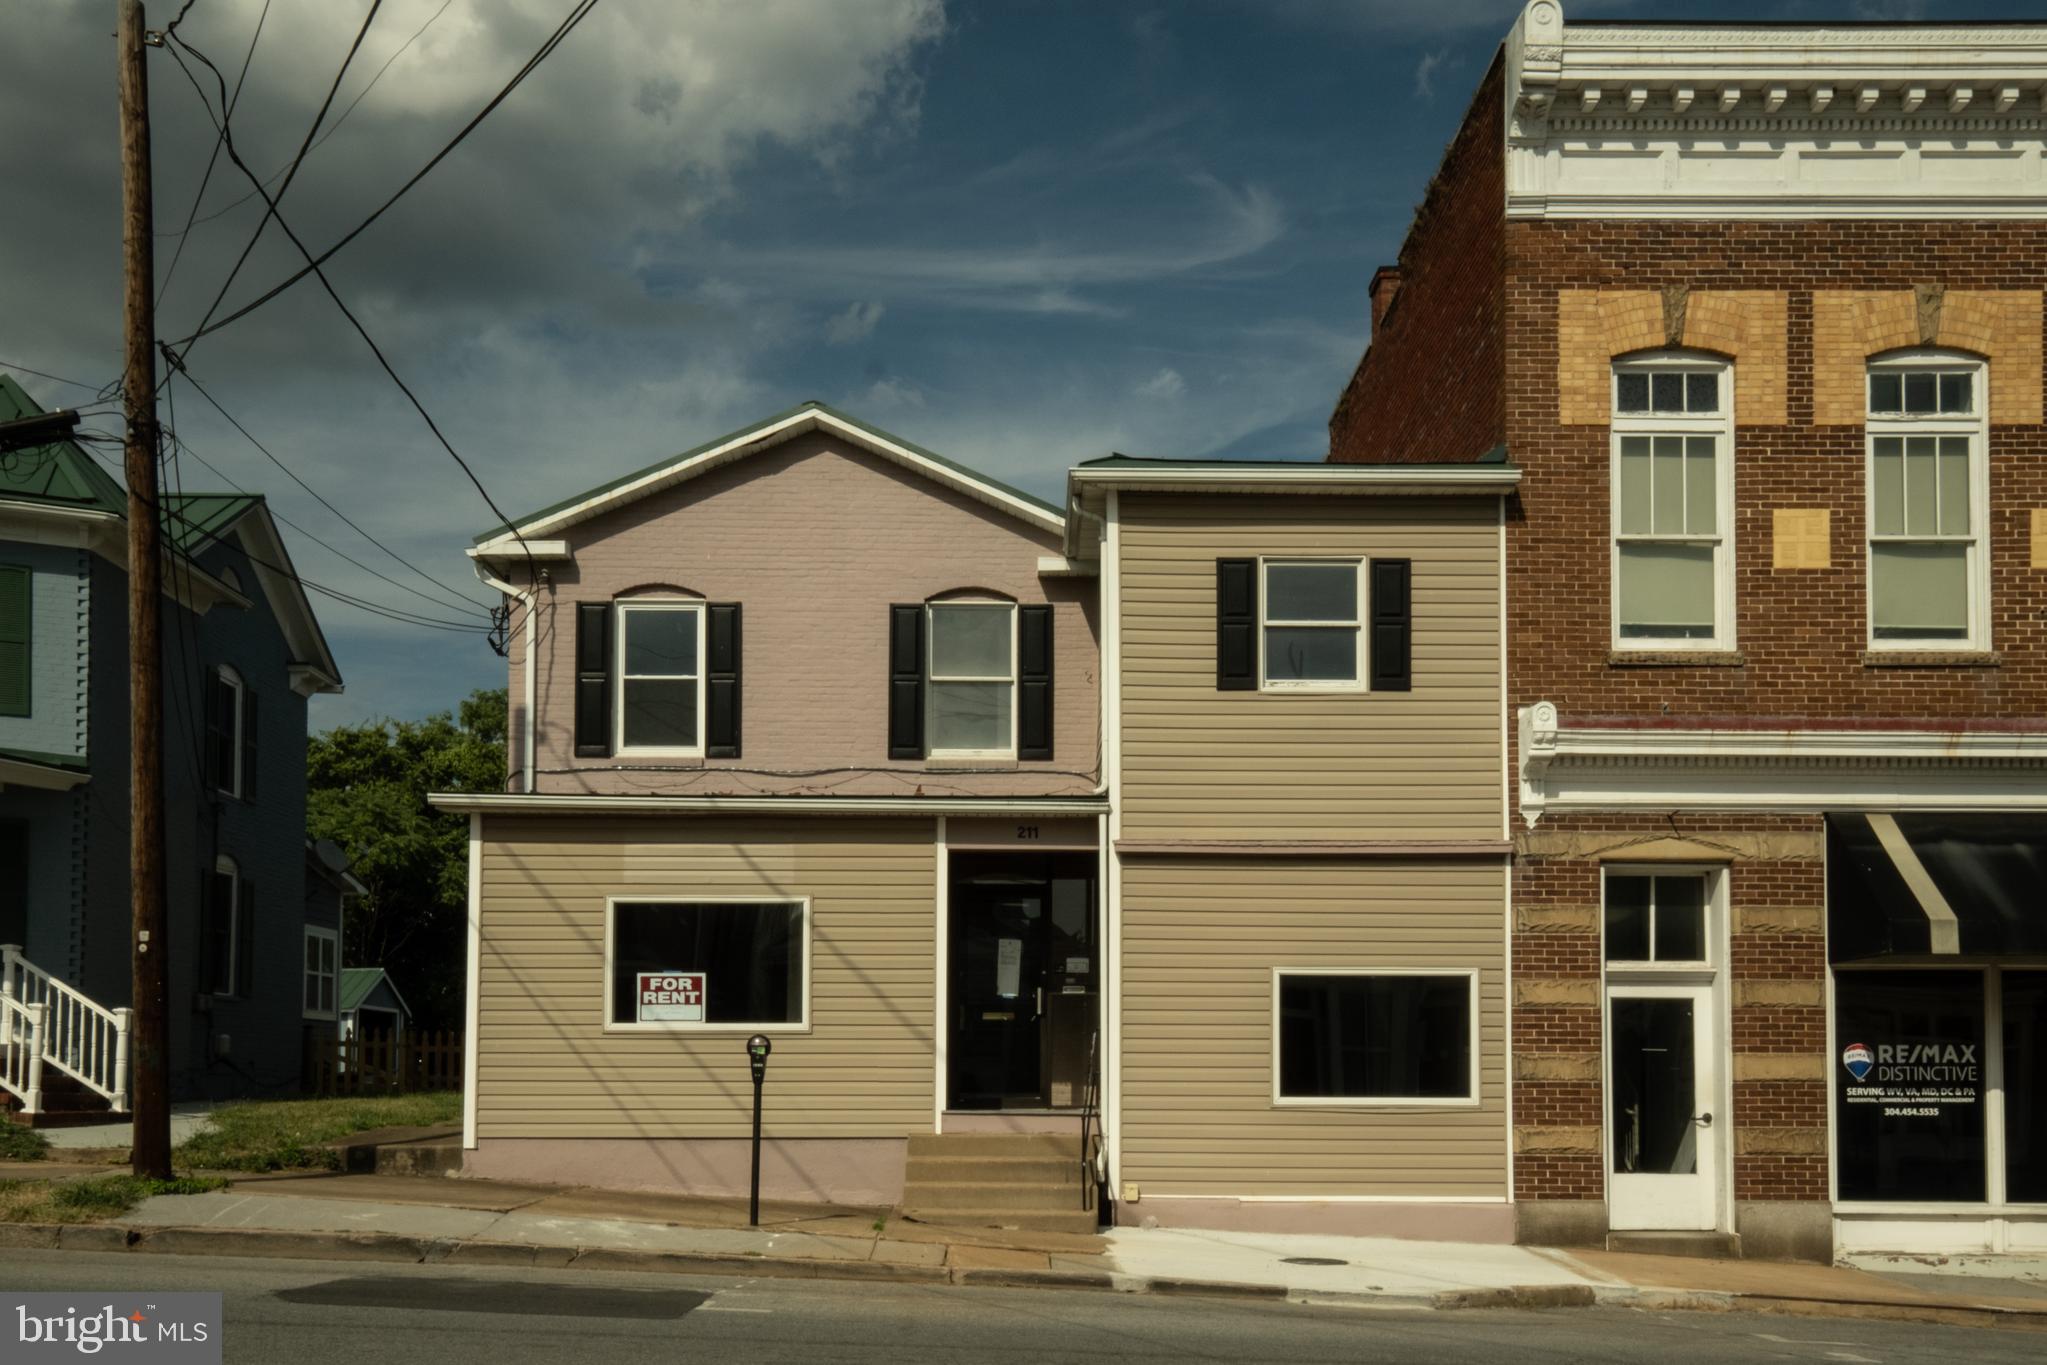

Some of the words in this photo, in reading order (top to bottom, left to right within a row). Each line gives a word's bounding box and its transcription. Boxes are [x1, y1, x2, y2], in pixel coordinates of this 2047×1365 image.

[1017, 826, 1039, 839] 211
[649, 977, 692, 991] FOR
[643, 991, 700, 1004] RENT
[1878, 1044, 1976, 1064] RE/MAX
[1878, 1066, 1977, 1081] DISTINCTIVE
[1846, 1087, 1885, 1096] SERVING
[1886, 1087, 1904, 1097] WV,
[1904, 1087, 1920, 1097] VA,
[1921, 1087, 1939, 1097] MD,
[1941, 1087, 1954, 1096] DC
[1955, 1087, 1962, 1096] &
[1963, 1087, 1976, 1096] PA
[1884, 1107, 1940, 1116] 304.454.5535
